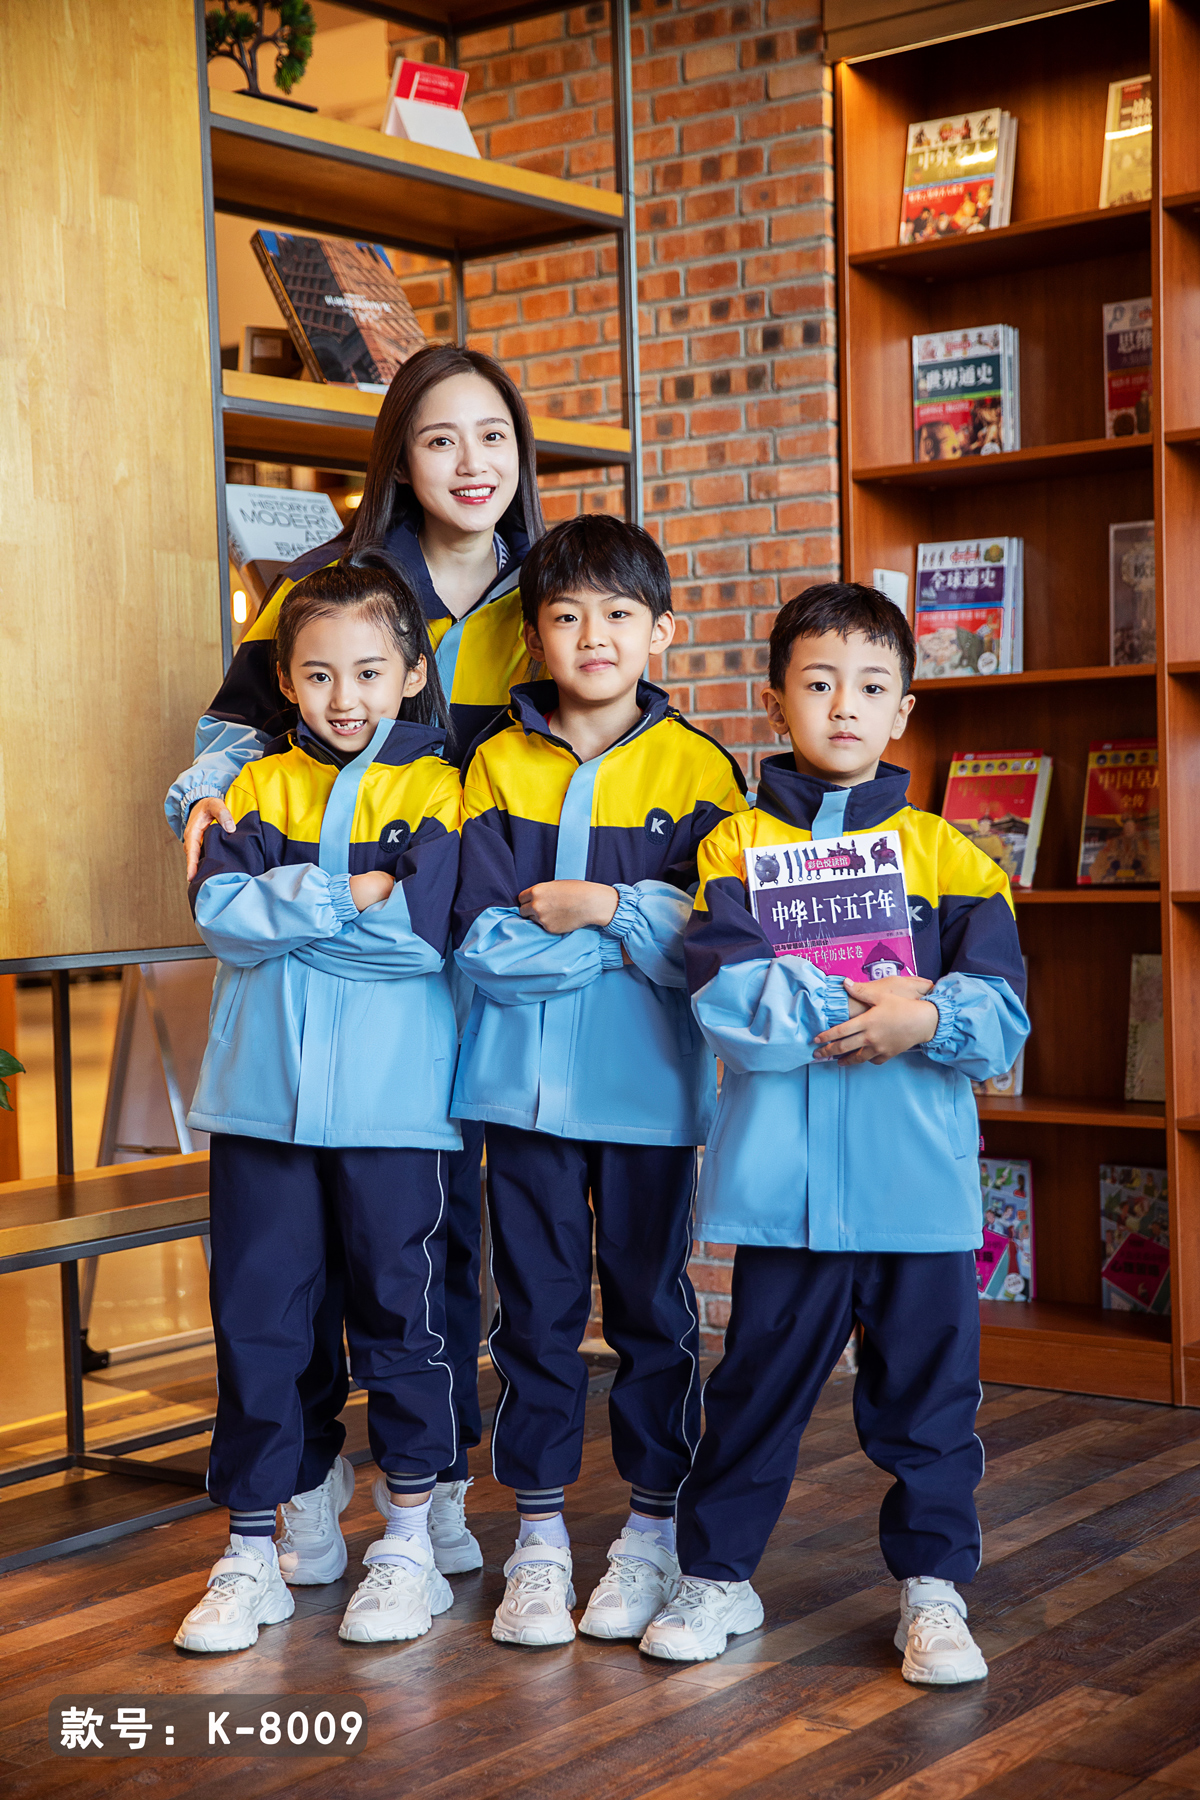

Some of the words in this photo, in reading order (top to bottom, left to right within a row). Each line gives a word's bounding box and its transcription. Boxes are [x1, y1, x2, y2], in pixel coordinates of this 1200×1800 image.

[926, 362, 994, 391] 世界通史
[250, 499, 307, 513] HISTORY
[310, 503, 330, 514] OF
[240, 508, 339, 530] MODERN
[931, 568, 997, 590] 全球通史
[651, 817, 667, 835] K
[387, 829, 403, 843] K
[807, 856, 848, 870] 彩色悦读馆
[771, 889, 896, 931] 中华上下五千年
[908, 905, 923, 922] K
